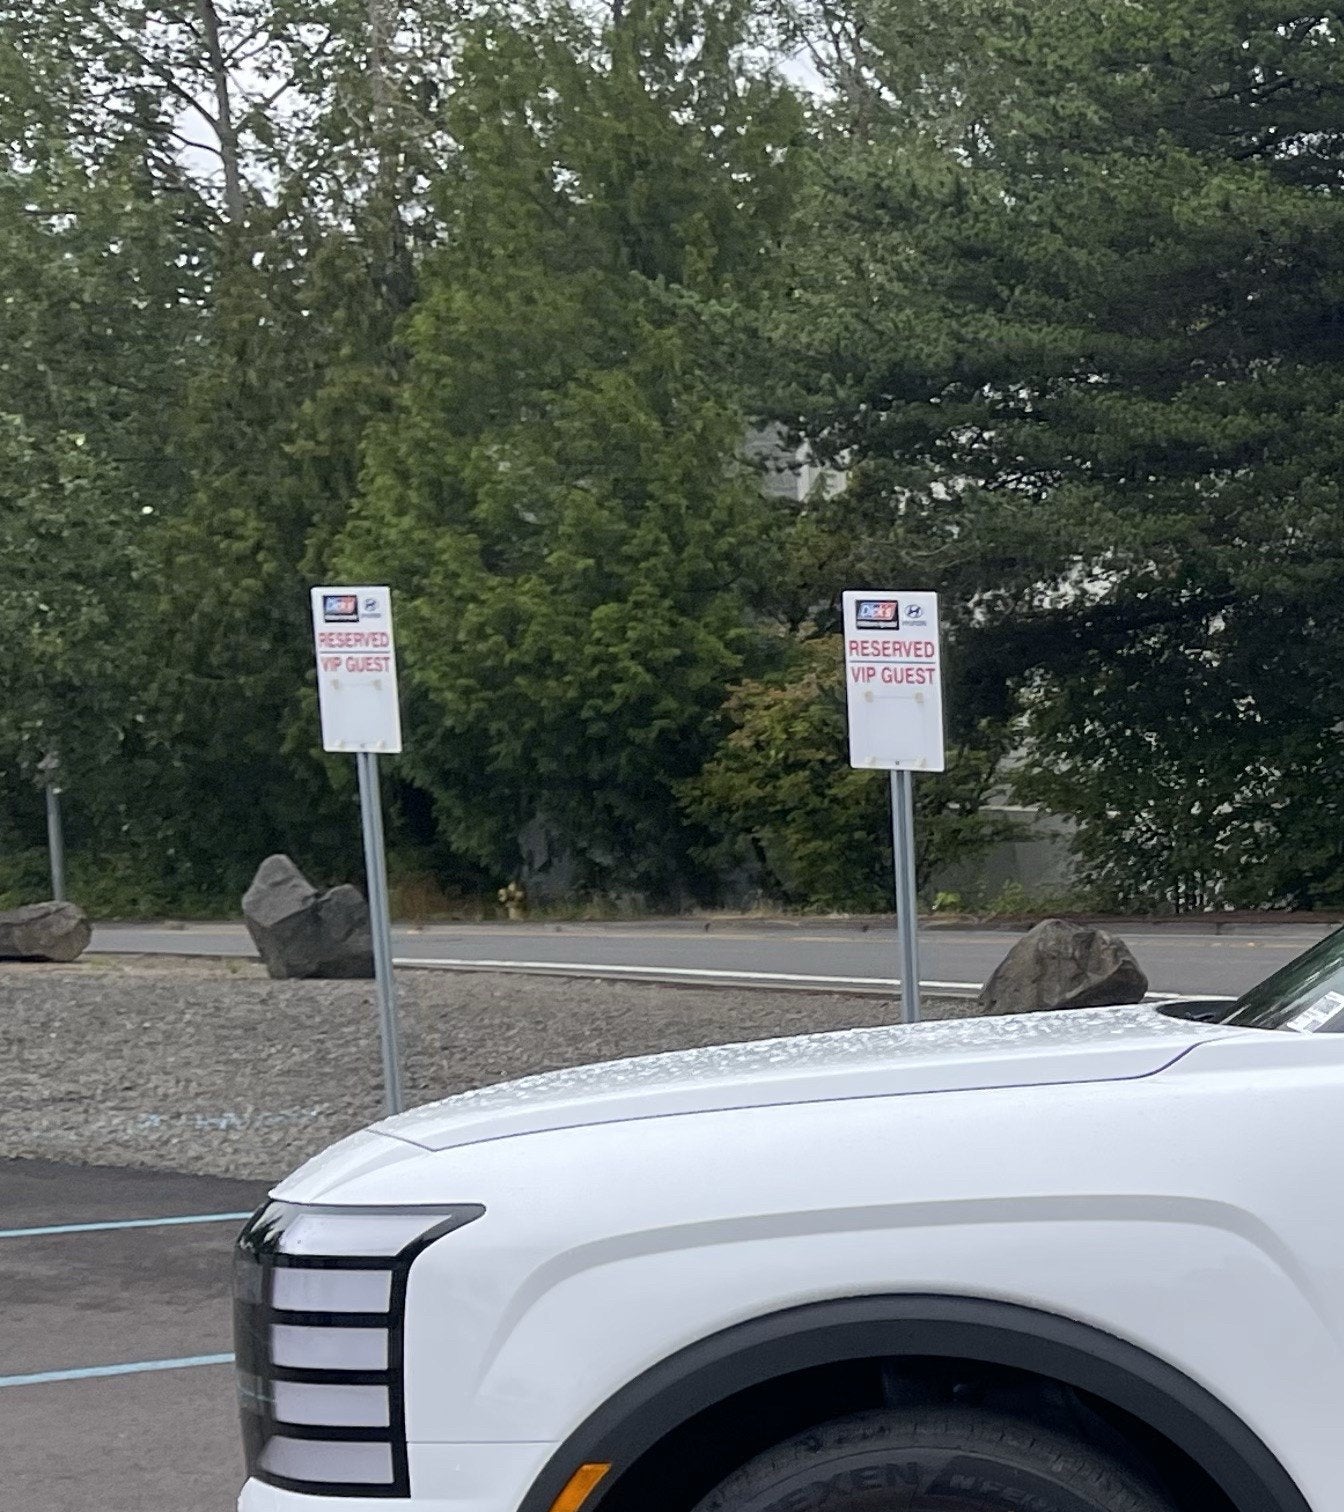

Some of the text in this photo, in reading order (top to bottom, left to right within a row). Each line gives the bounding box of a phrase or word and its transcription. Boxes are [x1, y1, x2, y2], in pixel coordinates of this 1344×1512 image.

[318, 631, 390, 648] RESERVED
[849, 639, 935, 658] RESERVED
[320, 656, 391, 673] VIP GUEST
[851, 666, 936, 685] VIP GUEST
